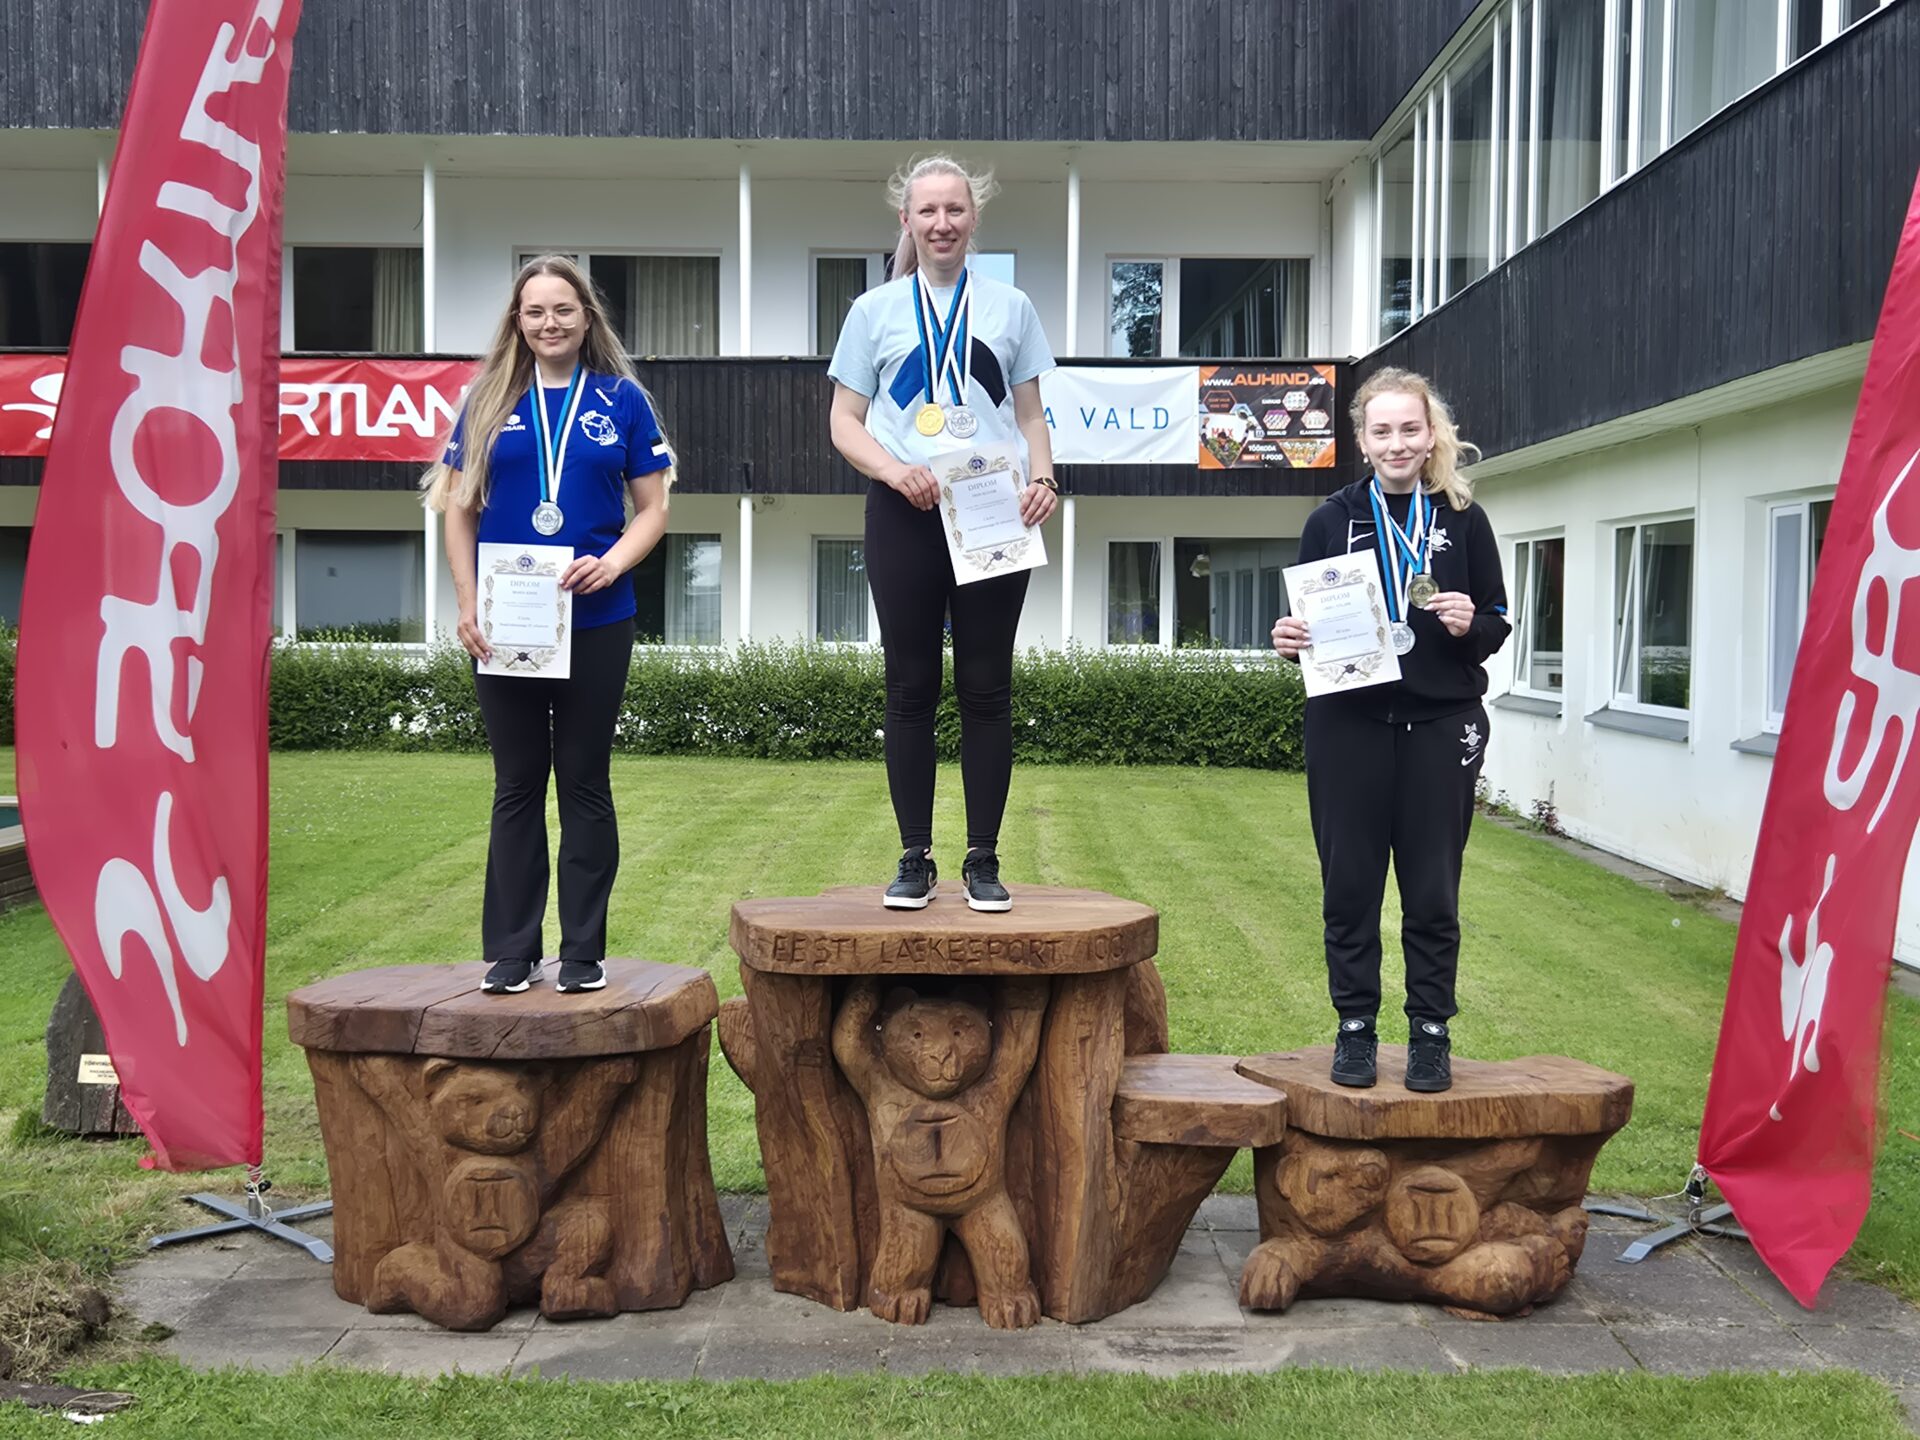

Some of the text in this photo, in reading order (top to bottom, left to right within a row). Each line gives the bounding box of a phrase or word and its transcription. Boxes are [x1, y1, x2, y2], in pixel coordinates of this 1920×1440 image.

[1080, 407, 1169, 430] VALD
[968, 479, 998, 492] DIPLOM
[1320, 592, 1351, 604] DIPLOM
[773, 934, 858, 965] EESTI
